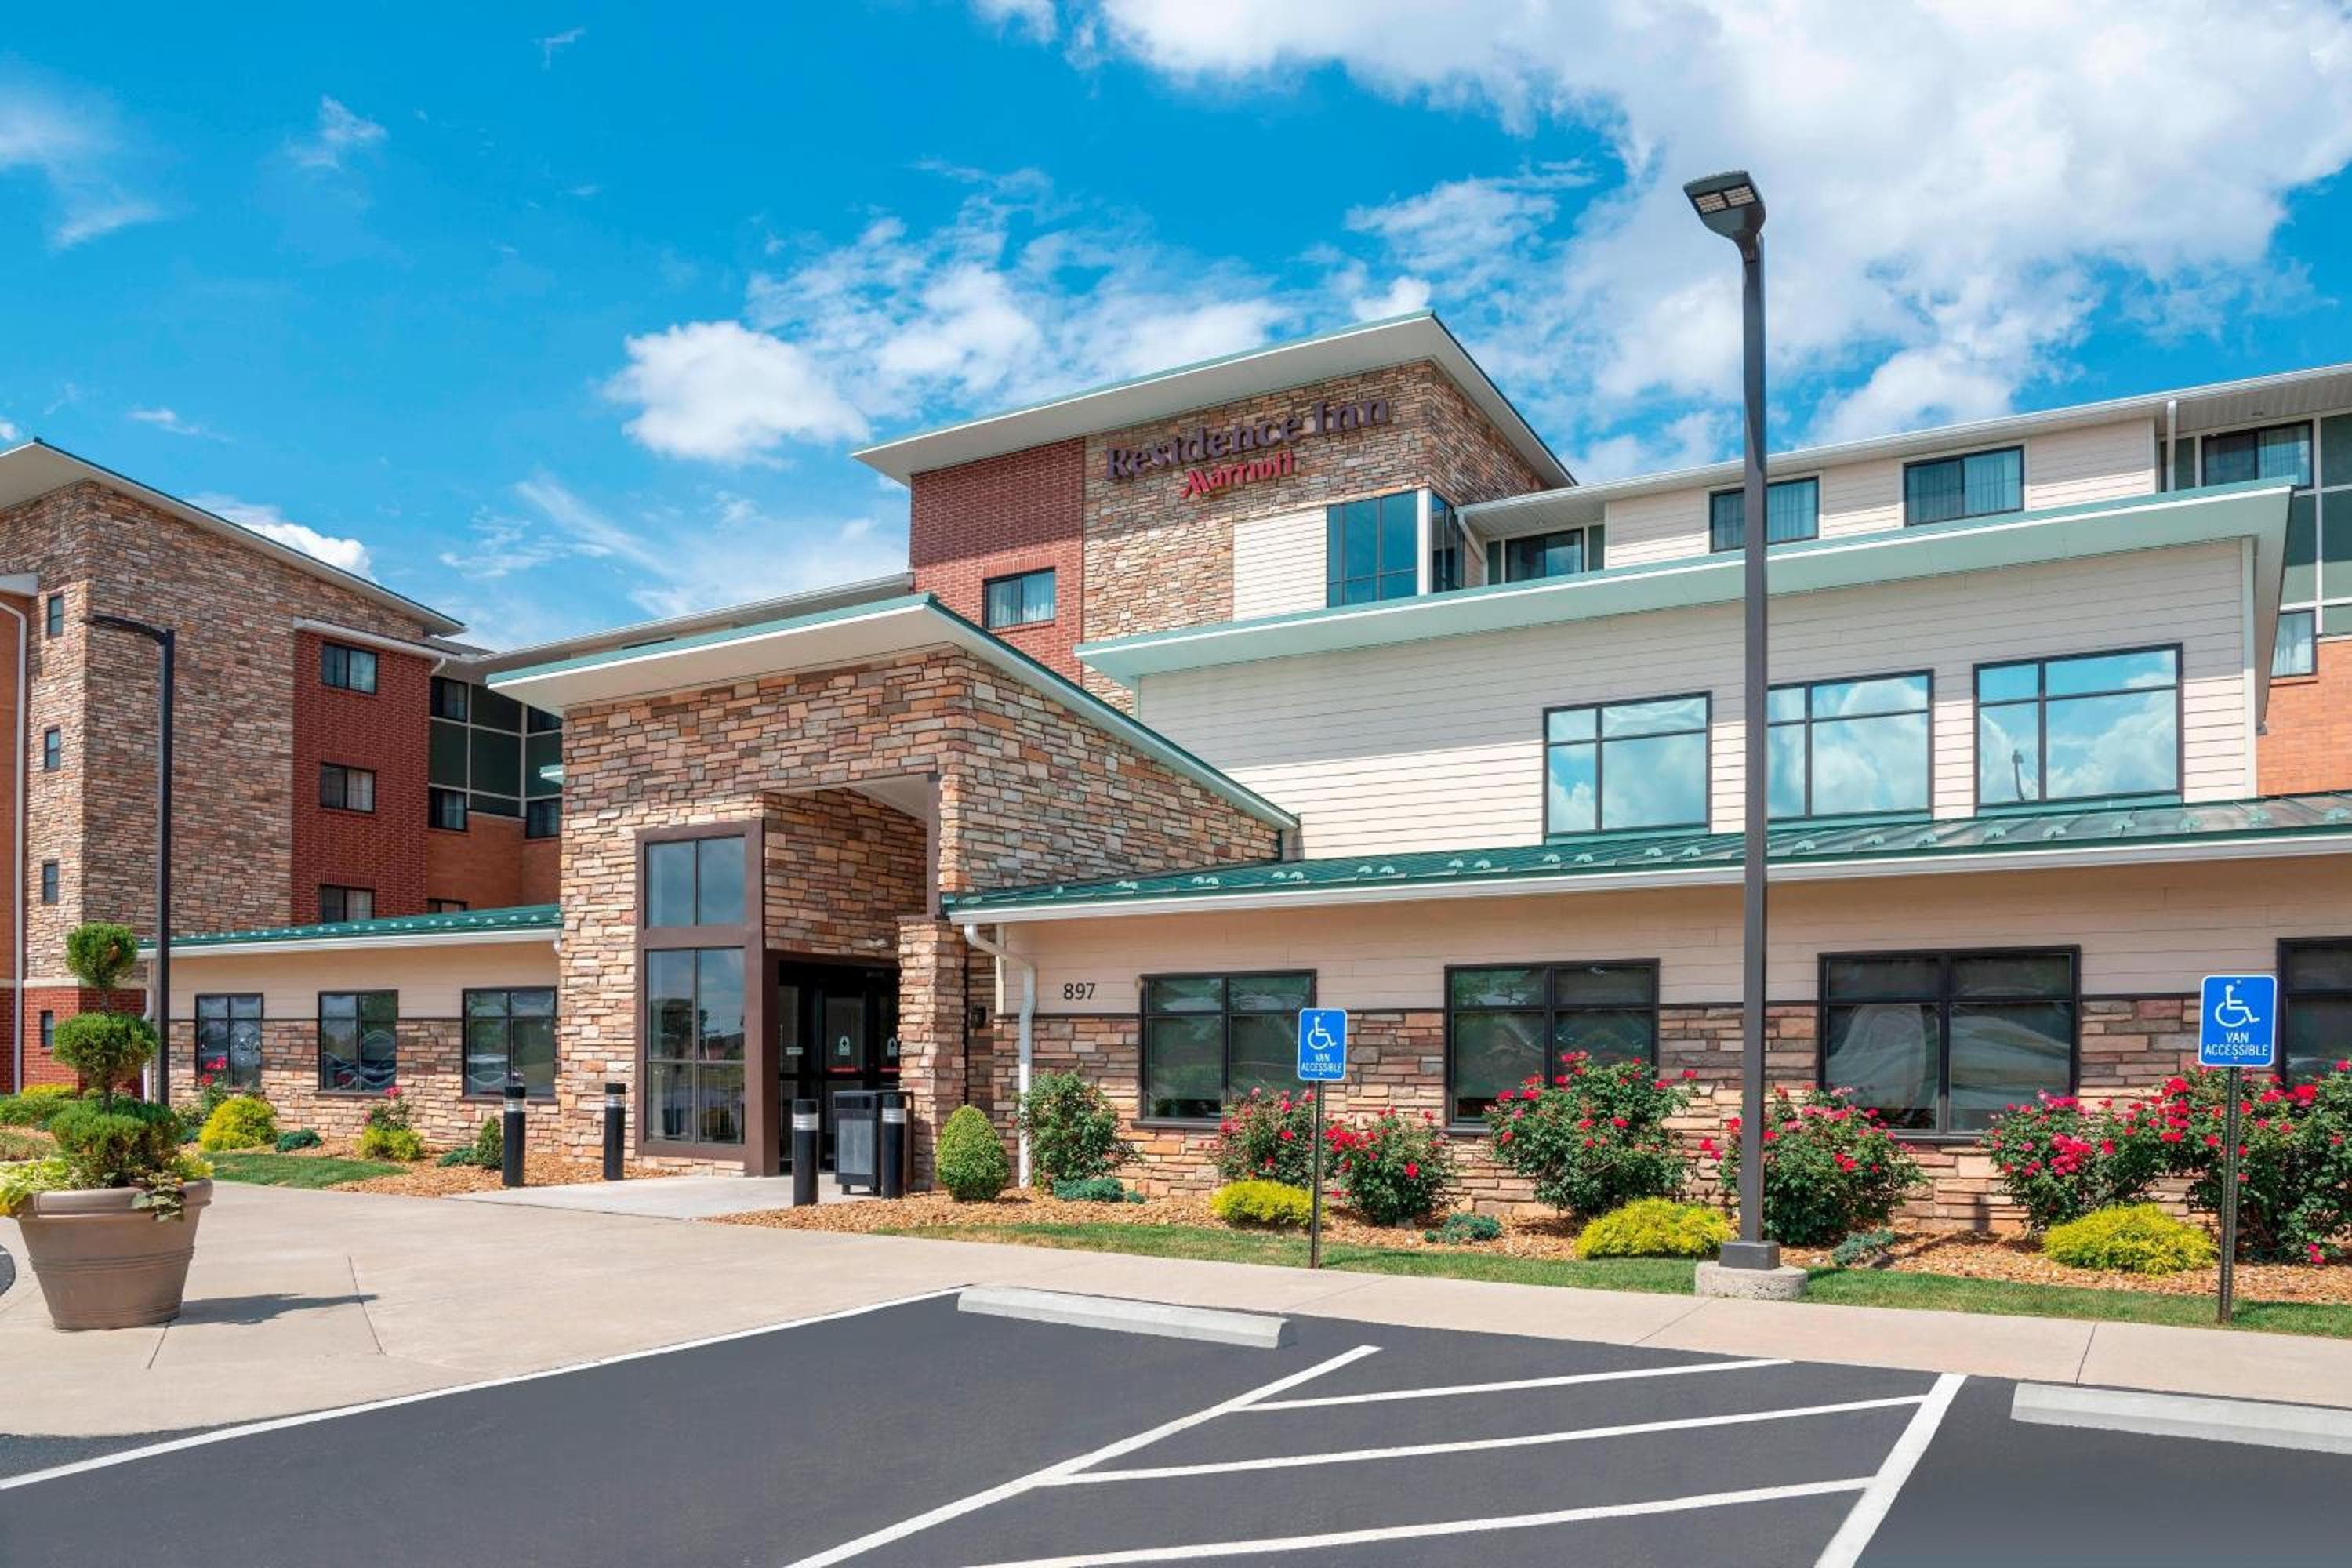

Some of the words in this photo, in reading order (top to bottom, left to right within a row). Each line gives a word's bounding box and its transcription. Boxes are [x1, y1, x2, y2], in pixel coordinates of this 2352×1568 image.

[1106, 416, 1303, 479] Residence
[1314, 398, 1390, 435] Inn
[1179, 451, 1294, 499] Marriott
[1064, 982, 1096, 1000] 897
[2225, 1031, 2249, 1044] VAN
[2204, 1044, 2269, 1057] ACCESSIBLE
[1315, 1053, 1330, 1062] VAN
[1301, 1062, 1343, 1073] ACCESSIBLE
